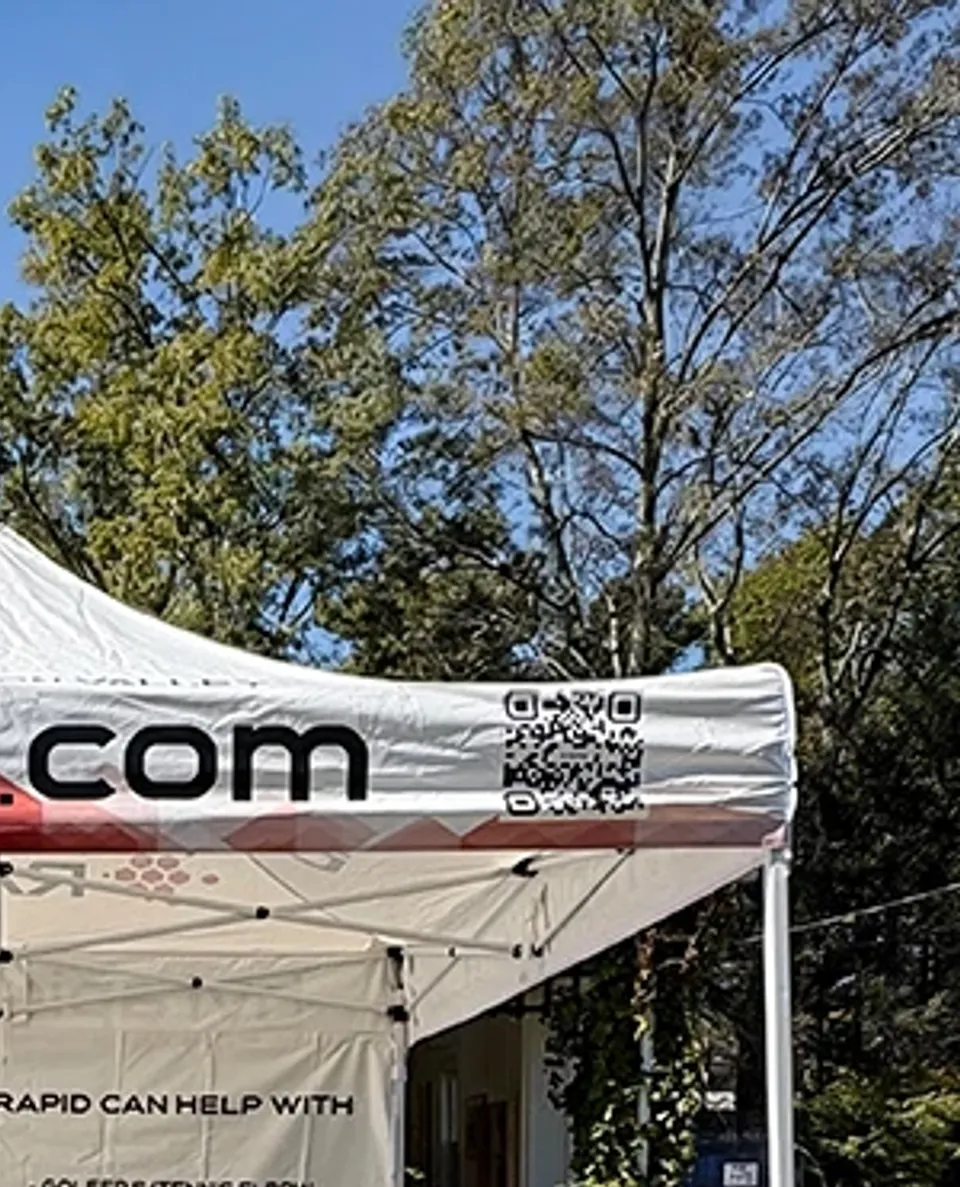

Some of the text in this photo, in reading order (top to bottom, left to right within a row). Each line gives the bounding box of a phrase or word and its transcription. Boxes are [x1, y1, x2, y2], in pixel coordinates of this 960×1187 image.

[100, 1093, 169, 1115] CAN
[175, 1093, 263, 1115] HELP
[271, 1094, 354, 1116] WITH
